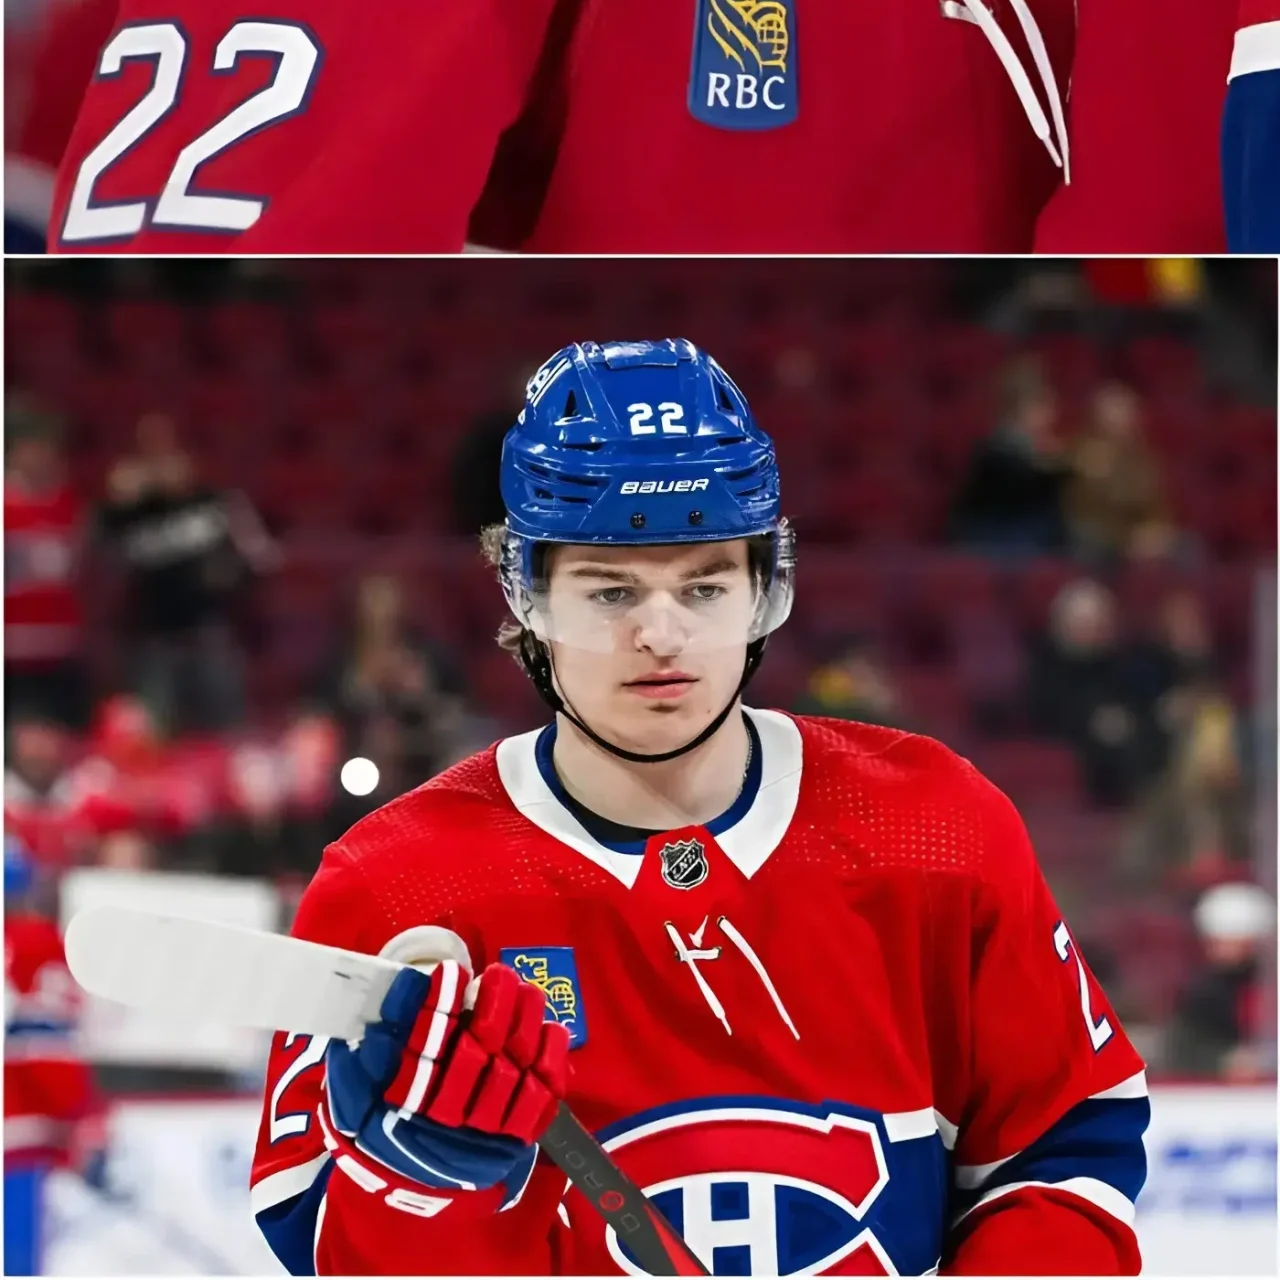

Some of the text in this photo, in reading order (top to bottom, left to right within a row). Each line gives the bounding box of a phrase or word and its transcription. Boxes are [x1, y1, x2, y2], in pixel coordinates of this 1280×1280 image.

[705, 71, 787, 111] RBC
[60, 20, 320, 240] 22
[626, 401, 688, 436] 22
[619, 478, 710, 495] BAUER
